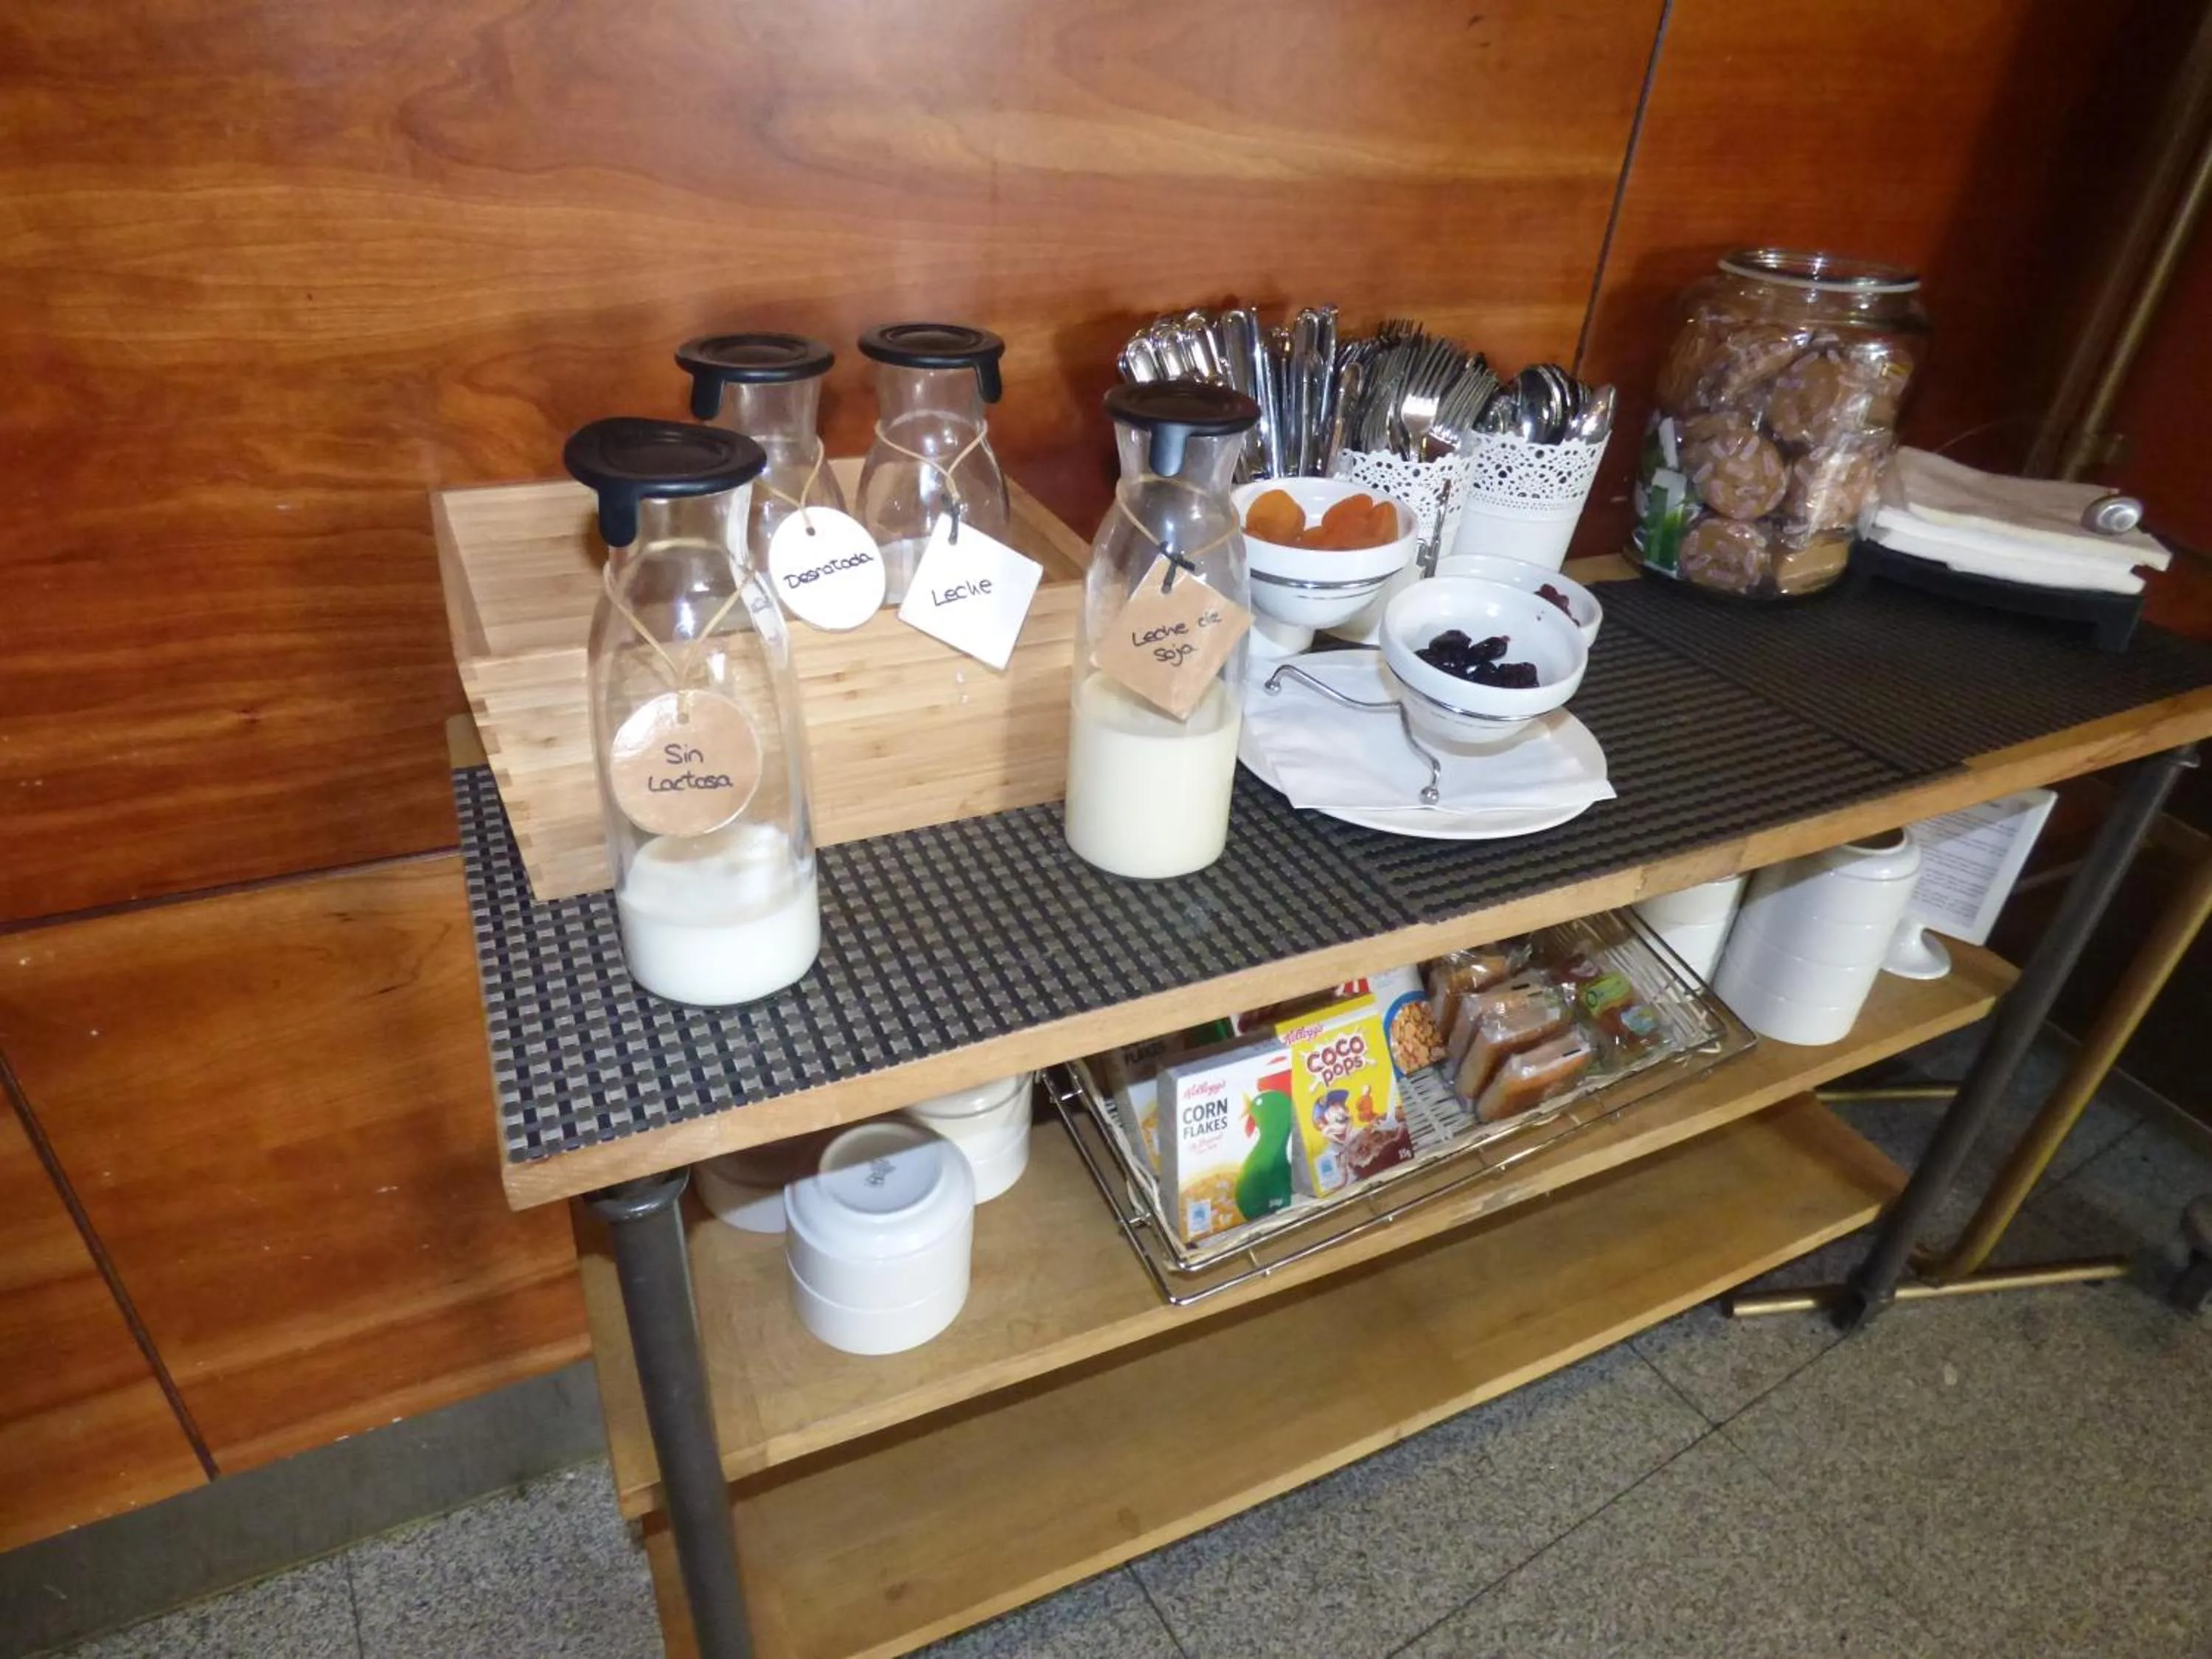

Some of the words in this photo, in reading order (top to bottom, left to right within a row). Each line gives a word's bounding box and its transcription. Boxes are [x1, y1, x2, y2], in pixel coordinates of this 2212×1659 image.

[931, 577, 992, 606] Leche
[1132, 622, 1189, 647] Leche
[664, 743, 703, 764] Sin
[647, 771, 734, 793] Lactosa
[1307, 1036, 1364, 1072] COCO
[1322, 1056, 1363, 1088] pops
[1183, 1097, 1228, 1125] CORN
[1183, 1116, 1228, 1140] FLAKES
